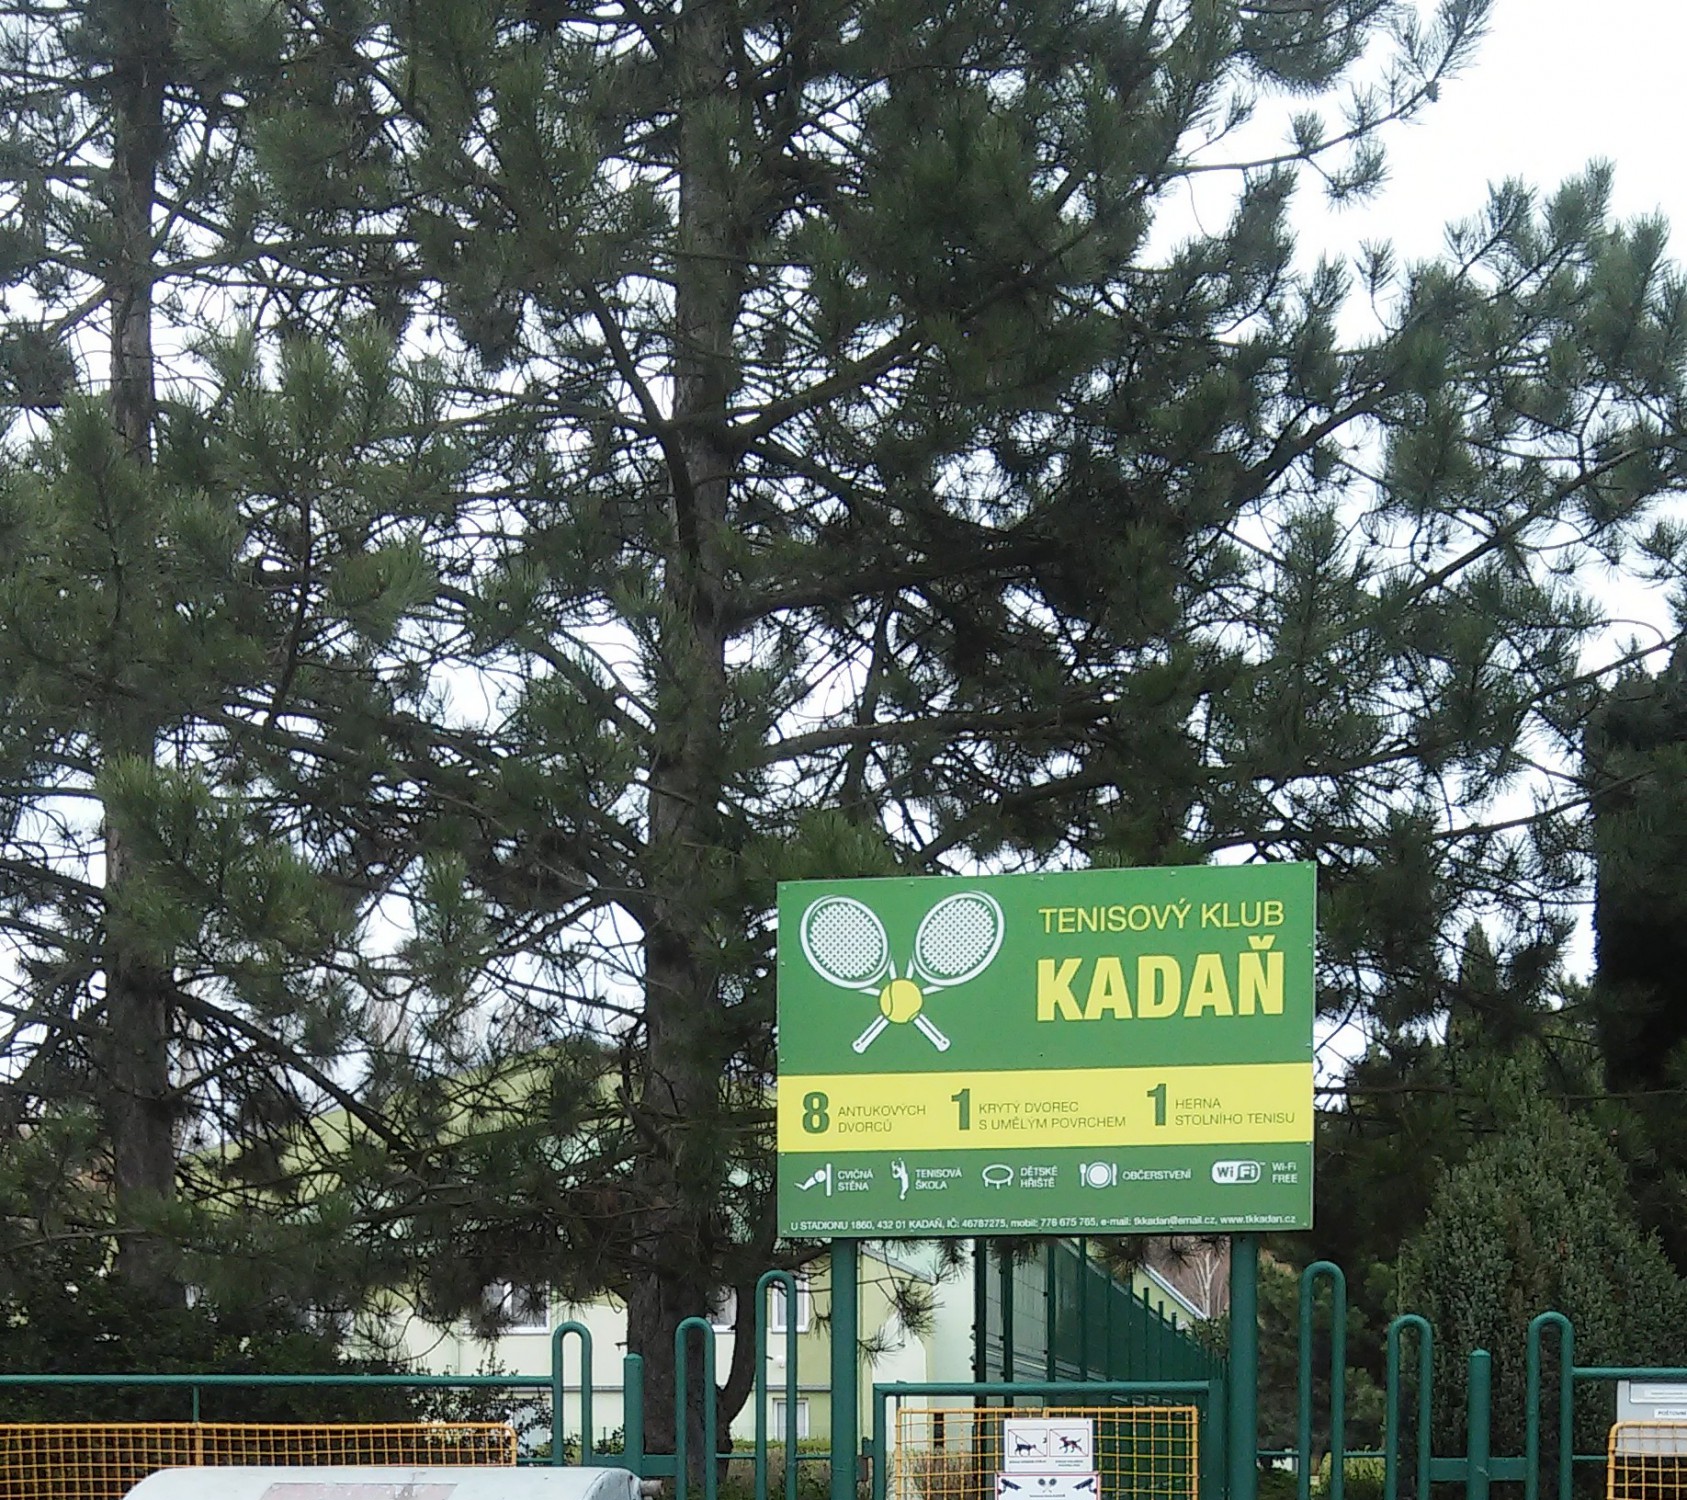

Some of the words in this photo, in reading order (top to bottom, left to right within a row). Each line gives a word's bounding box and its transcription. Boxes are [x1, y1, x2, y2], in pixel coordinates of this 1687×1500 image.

[1037, 897, 1192, 933] TENISOVÝ
[1201, 900, 1285, 929] KLUB
[1036, 934, 1285, 1022] KADAŇ
[837, 1104, 927, 1117] ANTUKOVÝCH
[951, 1088, 971, 1131] 1
[978, 1102, 1020, 1114] KRYTÝ
[1024, 1101, 1079, 1114] DVOREC
[1147, 1083, 1167, 1126] 1
[1175, 1098, 1221, 1110] HERNA
[802, 1091, 830, 1134] 8
[1175, 1112, 1243, 1126] STOLNÍHO
[1247, 1112, 1296, 1124] TENISU
[838, 1119, 893, 1133] DVORCŮ
[978, 1120, 987, 1131] S
[991, 1117, 1047, 1131] UMĚLÝM
[1051, 1116, 1126, 1129] POVRCHEM
[837, 1168, 874, 1181] CVIČNÁ
[915, 1167, 962, 1179] TENISOVÁ
[1020, 1166, 1058, 1178] DĚTSKÉ
[1122, 1168, 1192, 1181] OBČERSTVENÍ
[1271, 1172, 1298, 1184] FREE
[837, 1180, 870, 1192] STĚNA
[915, 1179, 948, 1190] ŠKOLA
[1020, 1177, 1056, 1189] HŘIŠTĚ
[790, 1222, 798, 1231] U
[800, 1221, 848, 1231] STADIONU
[877, 1220, 894, 1230] 432
[895, 1220, 906, 1230] 01
[1100, 1216, 1132, 1227] e-mail:
